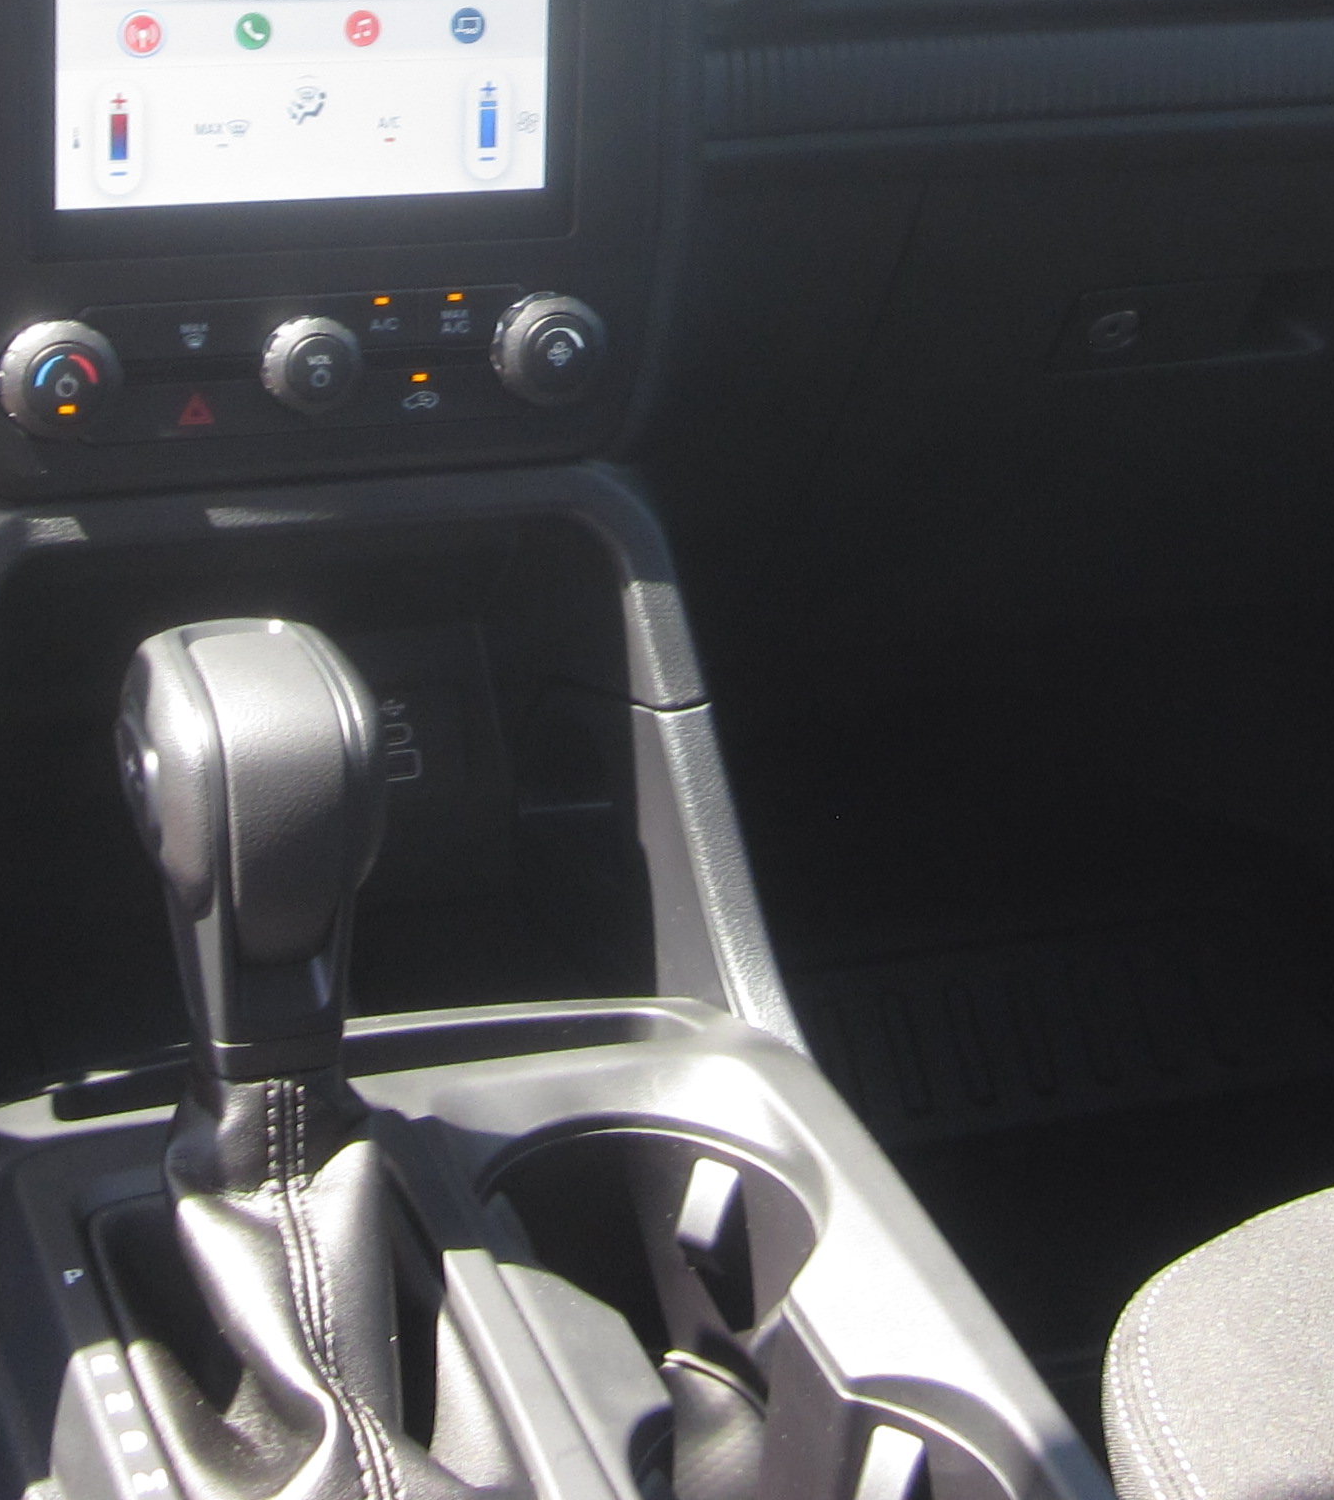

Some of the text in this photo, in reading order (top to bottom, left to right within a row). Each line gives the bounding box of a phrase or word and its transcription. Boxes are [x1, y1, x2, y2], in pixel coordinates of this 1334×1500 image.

[194, 123, 223, 135] MAX
[378, 116, 401, 129] A/C
[370, 317, 400, 332] A/C
[441, 320, 471, 334] A/C
[306, 355, 333, 366] VOL
[63, 1268, 84, 1285] P
[89, 1353, 120, 1377] R
[119, 1429, 149, 1454] D
